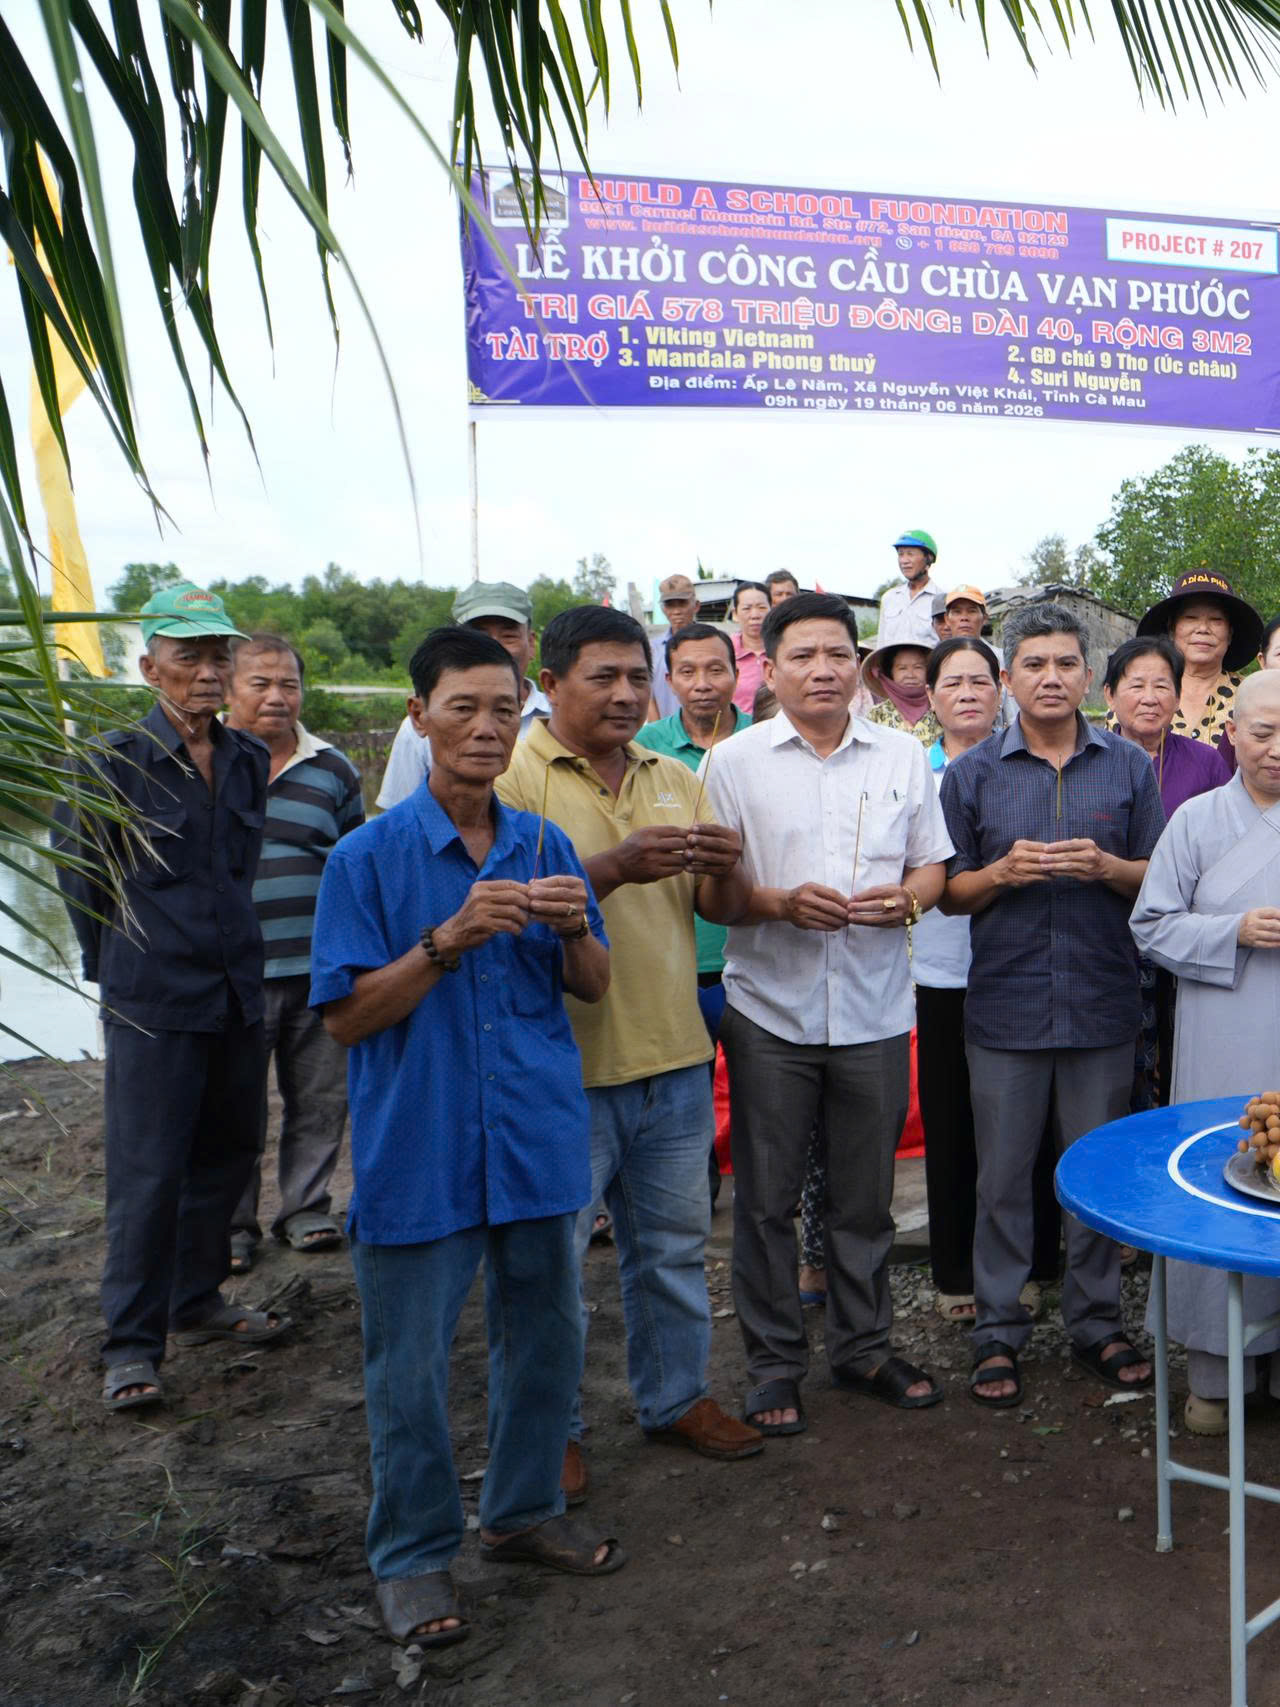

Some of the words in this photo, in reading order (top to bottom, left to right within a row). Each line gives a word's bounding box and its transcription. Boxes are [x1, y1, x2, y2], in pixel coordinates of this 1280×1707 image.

[580, 178, 682, 206] BUILD
[692, 186, 717, 208] A
[726, 189, 861, 219] SCHOOL
[870, 198, 1068, 234] FUONDATION
[630, 204, 697, 220] Carmel
[701, 208, 785, 227] Mountain
[897, 222, 931, 236] San
[991, 229, 1014, 243] CA
[935, 238, 944, 252] 1
[1121, 231, 1207, 256] PROJECT
[1212, 239, 1225, 257] #
[1230, 240, 1263, 261] 207
[515, 227, 570, 281] LỄ
[581, 235, 688, 283] KHỞI
[698, 244, 817, 289] CÔNG
[828, 246, 910, 295] CẦU
[920, 260, 1028, 303] CHÙA
[1037, 272, 1118, 315] VẠN
[1127, 278, 1250, 320] PHƯỚC
[516, 293, 578, 324] TRỊ
[588, 289, 654, 322] GIÁ
[662, 296, 724, 323] 578
[731, 296, 840, 331] TRIỆU
[848, 297, 963, 334] ĐỒNG:
[972, 307, 1029, 338] DÀI
[1036, 317, 1083, 346] 40,
[1092, 317, 1184, 350] RỘNG
[1192, 329, 1252, 356] 3M2
[618, 326, 639, 345] 1.
[645, 326, 716, 348] Viking
[722, 328, 815, 349] Vietnam
[486, 326, 538, 361] TÀI
[543, 330, 609, 367] TRỢ
[618, 348, 640, 367] 3.
[647, 348, 746, 369] Mandala
[752, 350, 823, 373] Phong
[829, 353, 876, 375] thuỷ
[1008, 345, 1026, 362] 2.
[1061, 349, 1095, 368] chú
[1100, 353, 1112, 369] 9
[1153, 353, 1184, 375] (Úc
[1188, 359, 1237, 380] châu)
[649, 375, 680, 391] Địa
[685, 373, 737, 390] điểm:
[743, 373, 768, 392] Ấp
[774, 377, 796, 391] Lê
[802, 378, 849, 394] Năm,
[854, 380, 877, 393] Xã
[883, 381, 950, 396] Nguyễn
[955, 384, 989, 399] Việt
[994, 386, 1038, 402] Khái,
[1085, 391, 1108, 406] Cà
[1112, 394, 1146, 408] Mau
[1008, 367, 1026, 384] 4.
[1030, 368, 1068, 387] Suri
[1073, 371, 1142, 392] Nguyễn
[765, 394, 798, 407] 09h
[804, 395, 848, 410] ngày
[854, 397, 875, 410] 19
[880, 398, 931, 413] tháng
[936, 400, 957, 412] 06
[962, 402, 999, 415] năm
[1004, 404, 1044, 417] 2026
